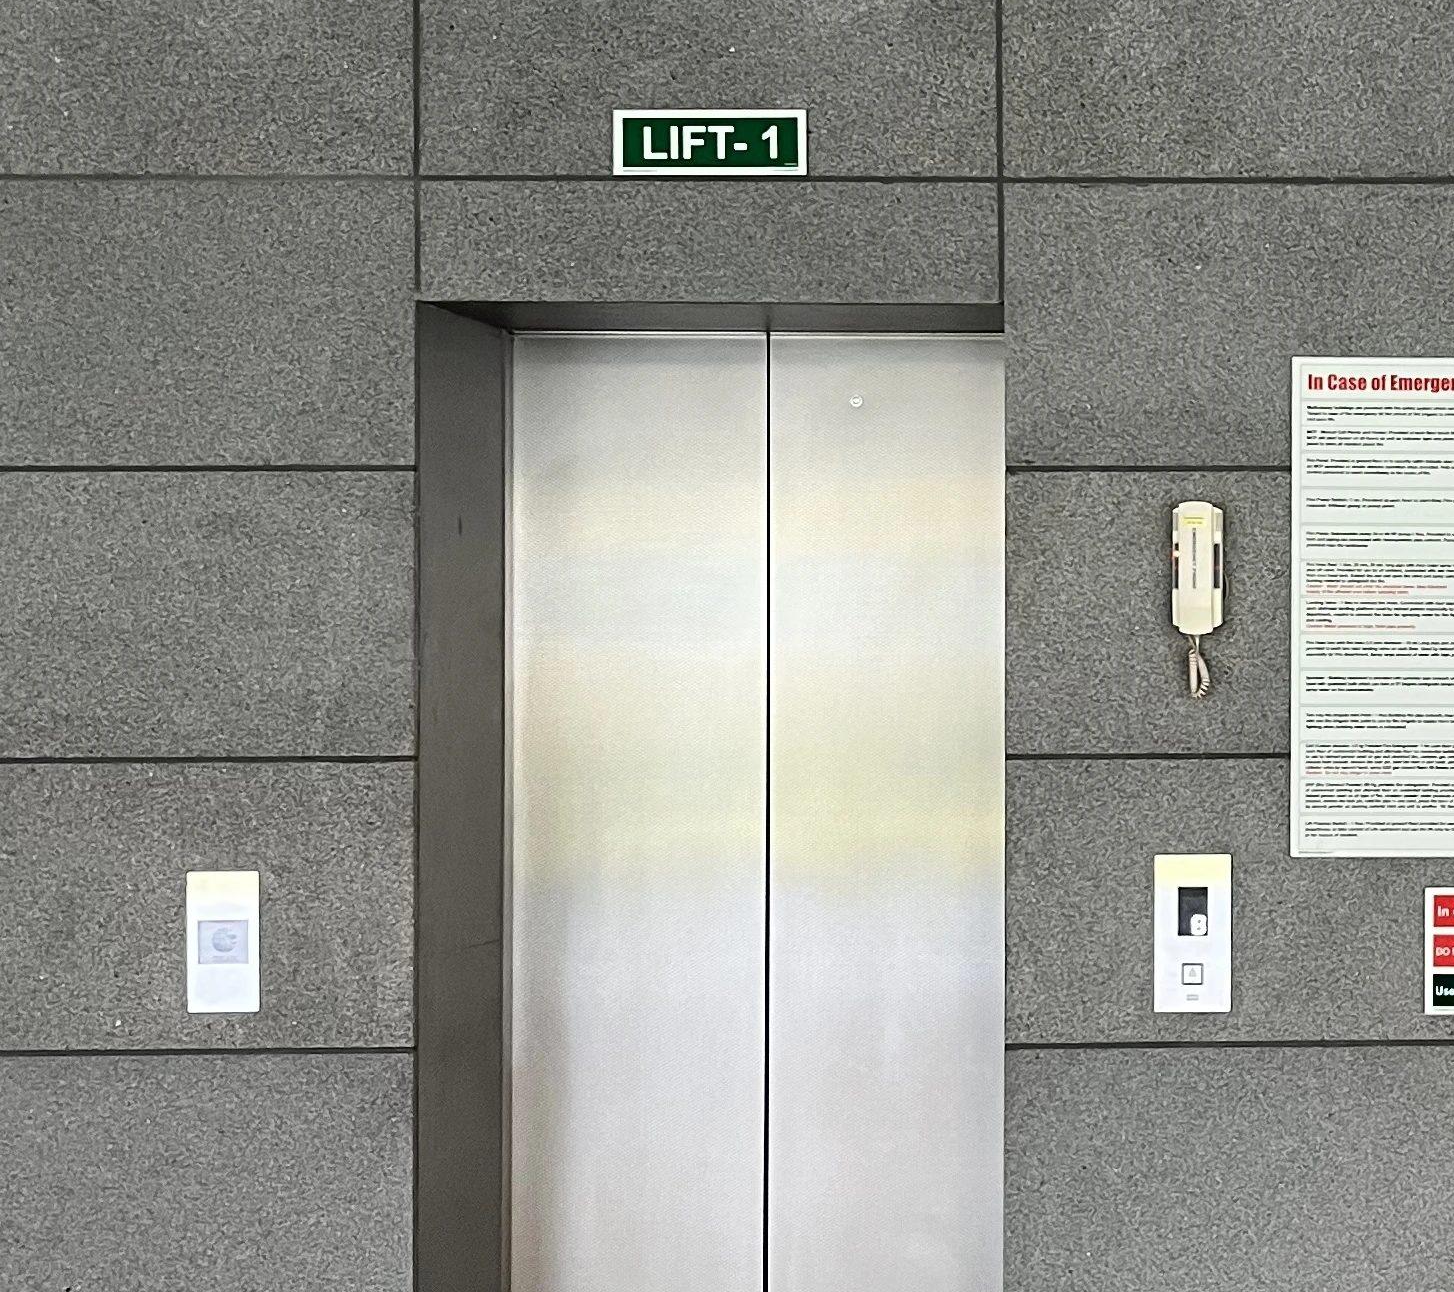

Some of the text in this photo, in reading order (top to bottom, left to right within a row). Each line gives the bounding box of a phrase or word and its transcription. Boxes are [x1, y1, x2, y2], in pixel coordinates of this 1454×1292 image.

[642, 124, 778, 159] LIFT- 1
[1307, 374, 1324, 391] In
[1327, 374, 1367, 391] Case
[1371, 375, 1387, 391] of
[1437, 906, 1450, 917] In
[1435, 946, 1450, 956] DO
[1435, 986, 1454, 996] Use
